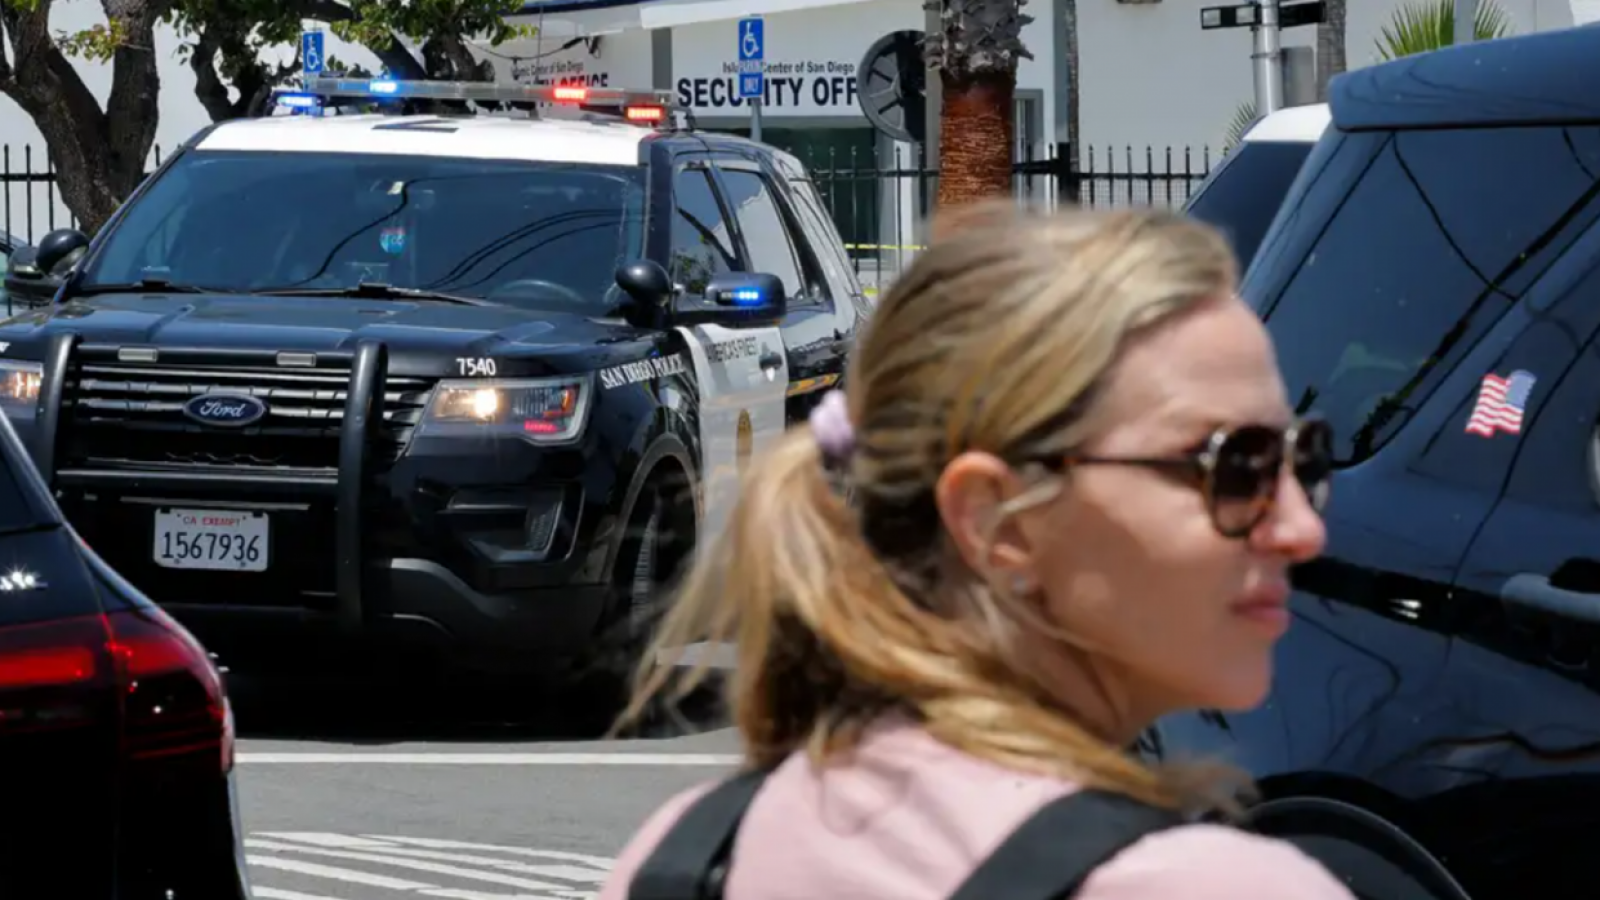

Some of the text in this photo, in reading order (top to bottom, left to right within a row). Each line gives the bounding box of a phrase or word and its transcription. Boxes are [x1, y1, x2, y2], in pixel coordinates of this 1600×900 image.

[762, 62, 793, 74] Center
[794, 61, 805, 73] of
[807, 61, 825, 73] San
[827, 61, 856, 76] Diego
[677, 76, 858, 107] SECUITY OFF
[455, 357, 496, 376] 7540
[600, 353, 686, 390] SAN DIEGO POLICE
[200, 401, 246, 417] Ford
[183, 516, 240, 527] CA EXEMPT
[161, 531, 261, 563] 1567936
